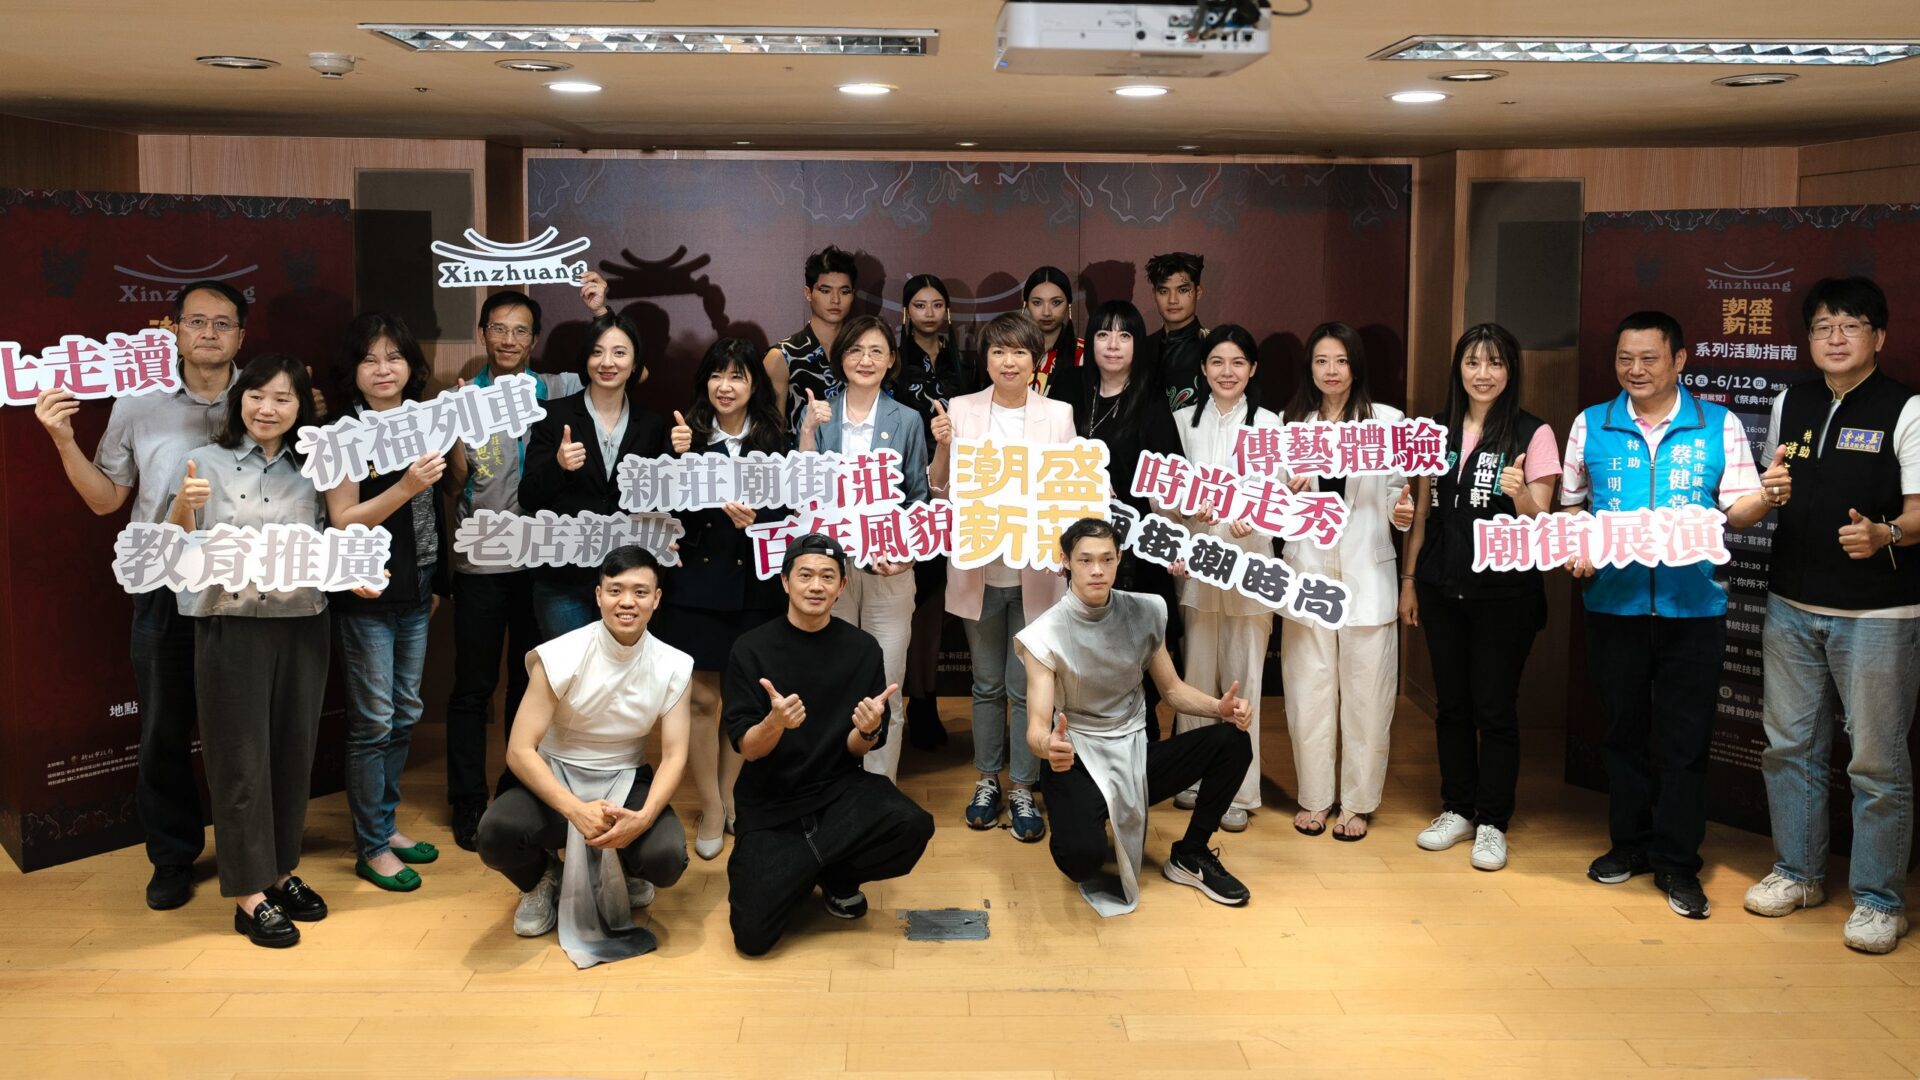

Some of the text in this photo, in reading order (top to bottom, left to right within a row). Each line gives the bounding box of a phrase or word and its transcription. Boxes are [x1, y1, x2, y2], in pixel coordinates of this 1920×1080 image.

[118, 285, 256, 303] Xinzg
[441, 260, 586, 285] Xinzhuang
[1707, 279, 1792, 292] Xinzhuang
[1695, 341, 1798, 361] 系列活動指南
[304, 377, 540, 485] 祈福列車
[1232, 423, 1447, 477] 傳藝體驗
[1626, 439, 1641, 469] 特助
[622, 456, 838, 508] 新莊廟街
[957, 439, 1103, 502] 潮盛
[1469, 452, 1499, 508] 陳世軒
[1607, 457, 1622, 511] 王明堂
[1135, 453, 1346, 546] 時尚走秀
[118, 525, 385, 590] 教育推廣
[1478, 510, 1724, 567] 廟街展演
[109, 700, 139, 718] 地點
